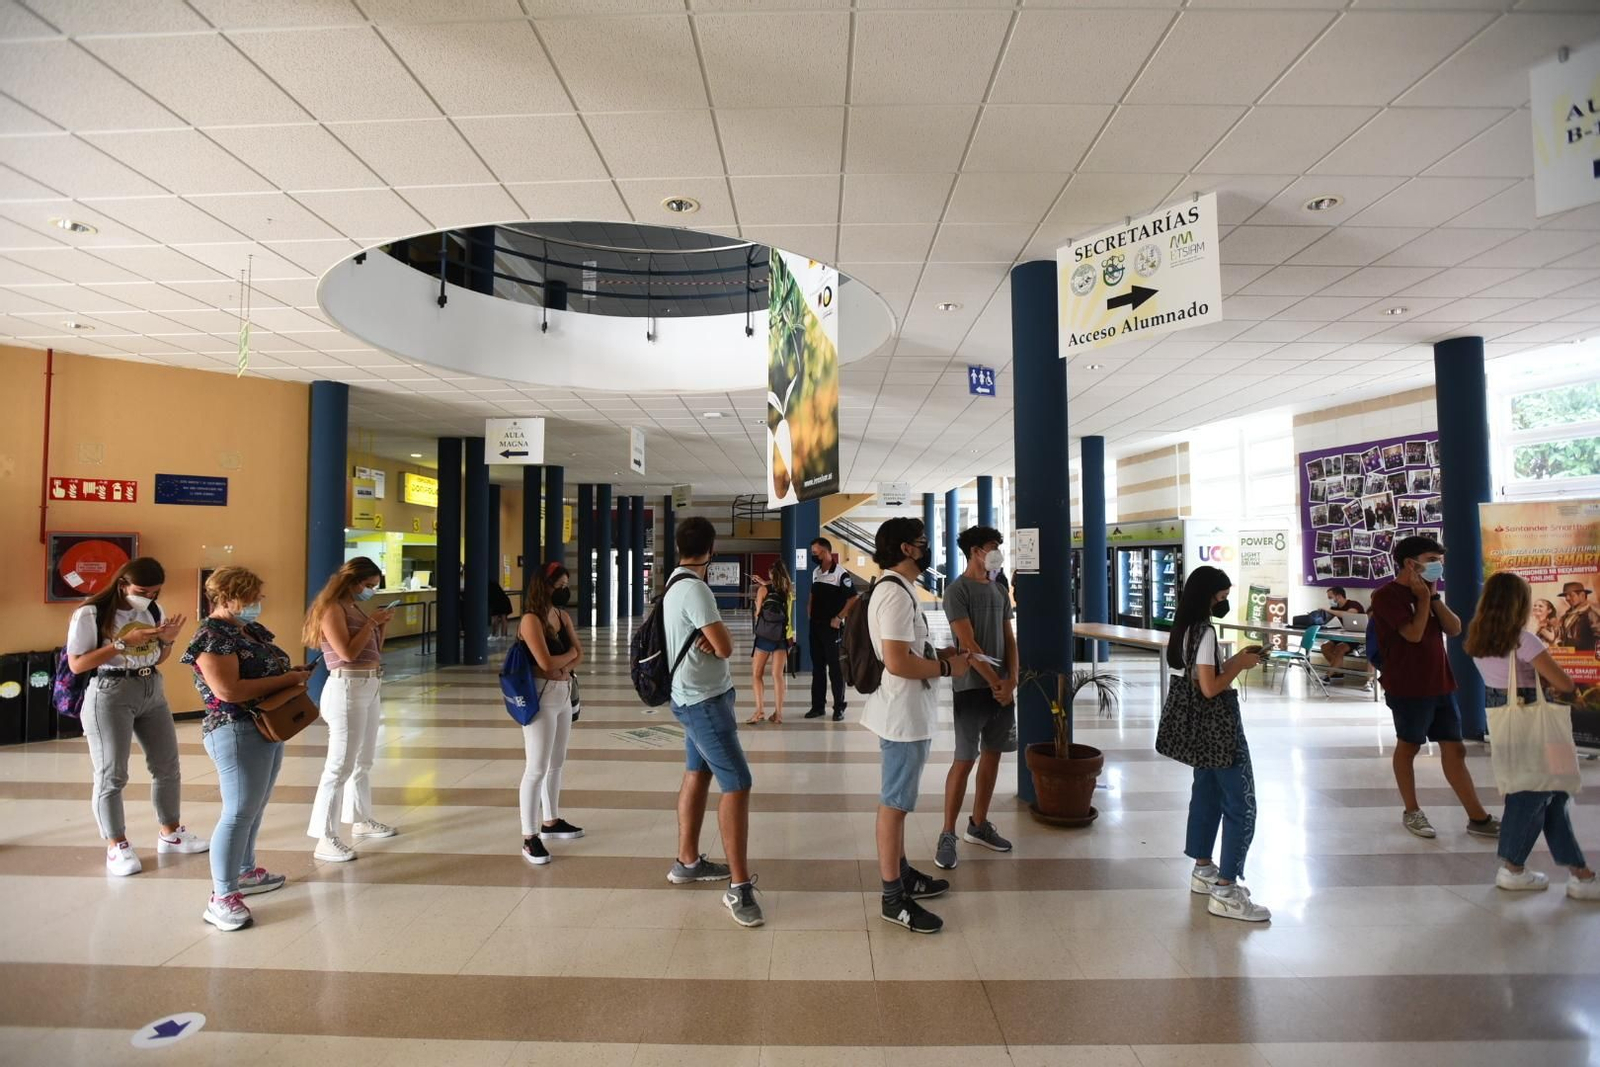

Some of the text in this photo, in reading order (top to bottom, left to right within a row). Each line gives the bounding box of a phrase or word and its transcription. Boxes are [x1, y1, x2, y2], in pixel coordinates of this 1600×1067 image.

[1074, 206, 1199, 262] SECRETARÍAS
[1068, 301, 1209, 347] Acceso Alumnado
[375, 515, 381, 529] 2
[413, 519, 419, 532] 3
[1505, 525, 1548, 533] Santander
[1199, 546, 1234, 562] UCO
[1507, 555, 1551, 568] CUENTA
[1553, 552, 1600, 567] SMART
